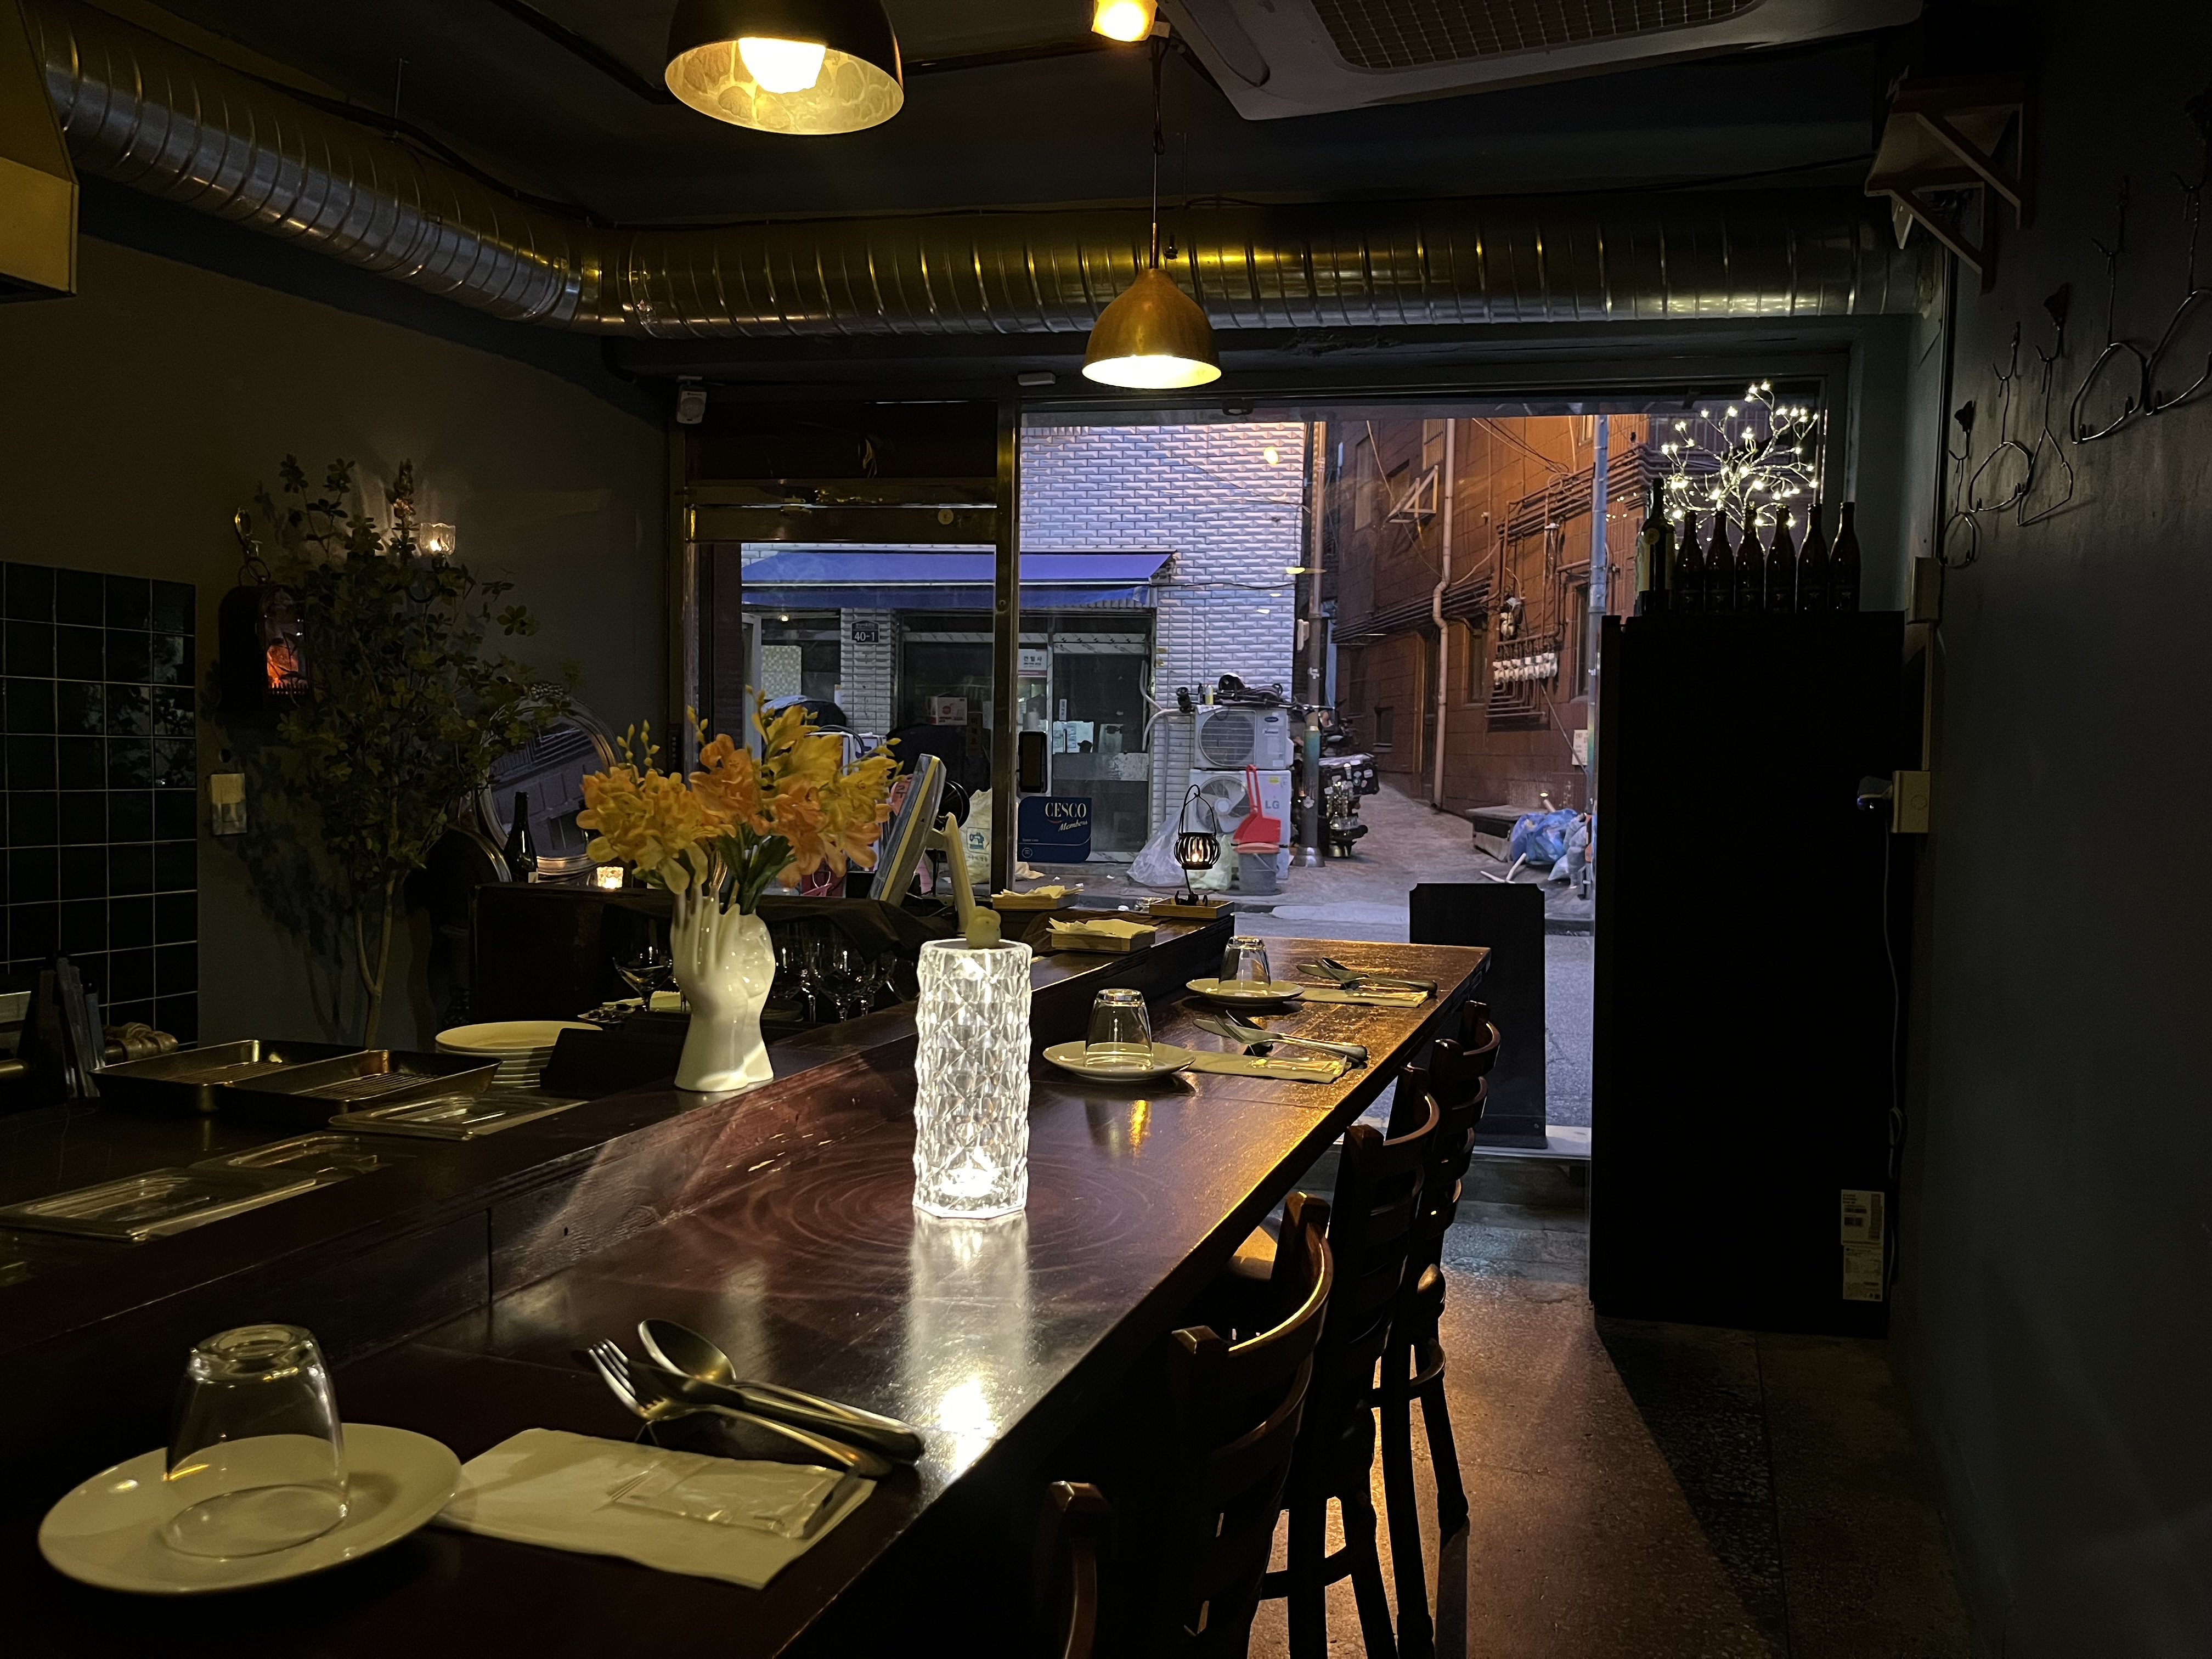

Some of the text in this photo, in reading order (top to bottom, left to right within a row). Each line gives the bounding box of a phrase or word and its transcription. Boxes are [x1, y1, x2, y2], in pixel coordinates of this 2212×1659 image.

[854, 631, 875, 641] 40-1
[1045, 802, 1087, 818] CESCO
[1265, 800, 1279, 809] LG
[1058, 819, 1088, 832] Members
